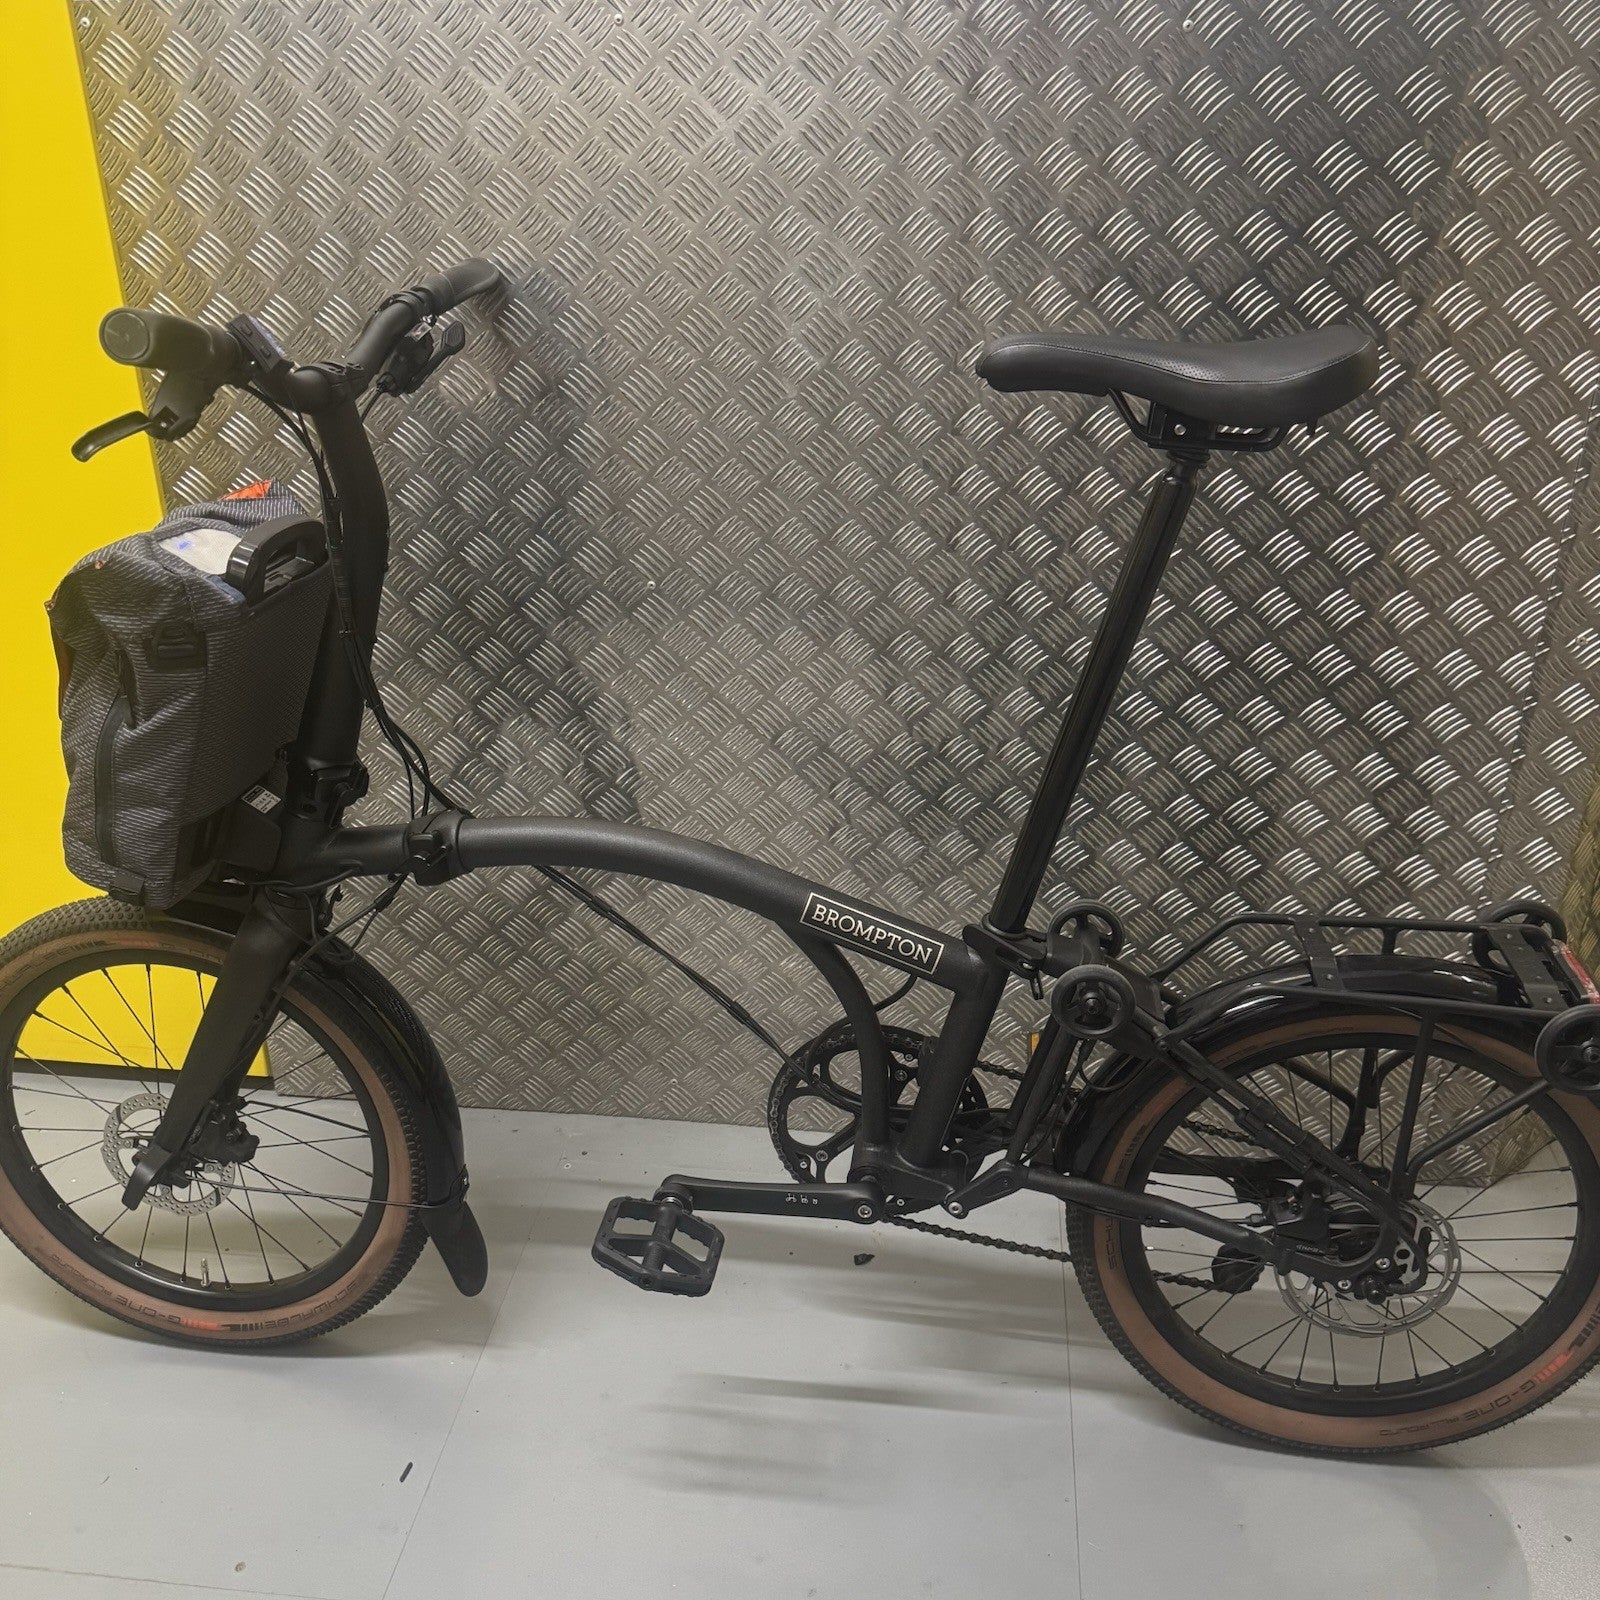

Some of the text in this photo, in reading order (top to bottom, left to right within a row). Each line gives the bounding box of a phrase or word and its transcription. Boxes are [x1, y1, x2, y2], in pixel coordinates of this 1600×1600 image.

[811, 904, 933, 964] BROMPTON
[116, 1294, 181, 1324] G-ONE
[264, 1280, 359, 1329] SCHWALBE
[1463, 1379, 1536, 1422] G-ONE
